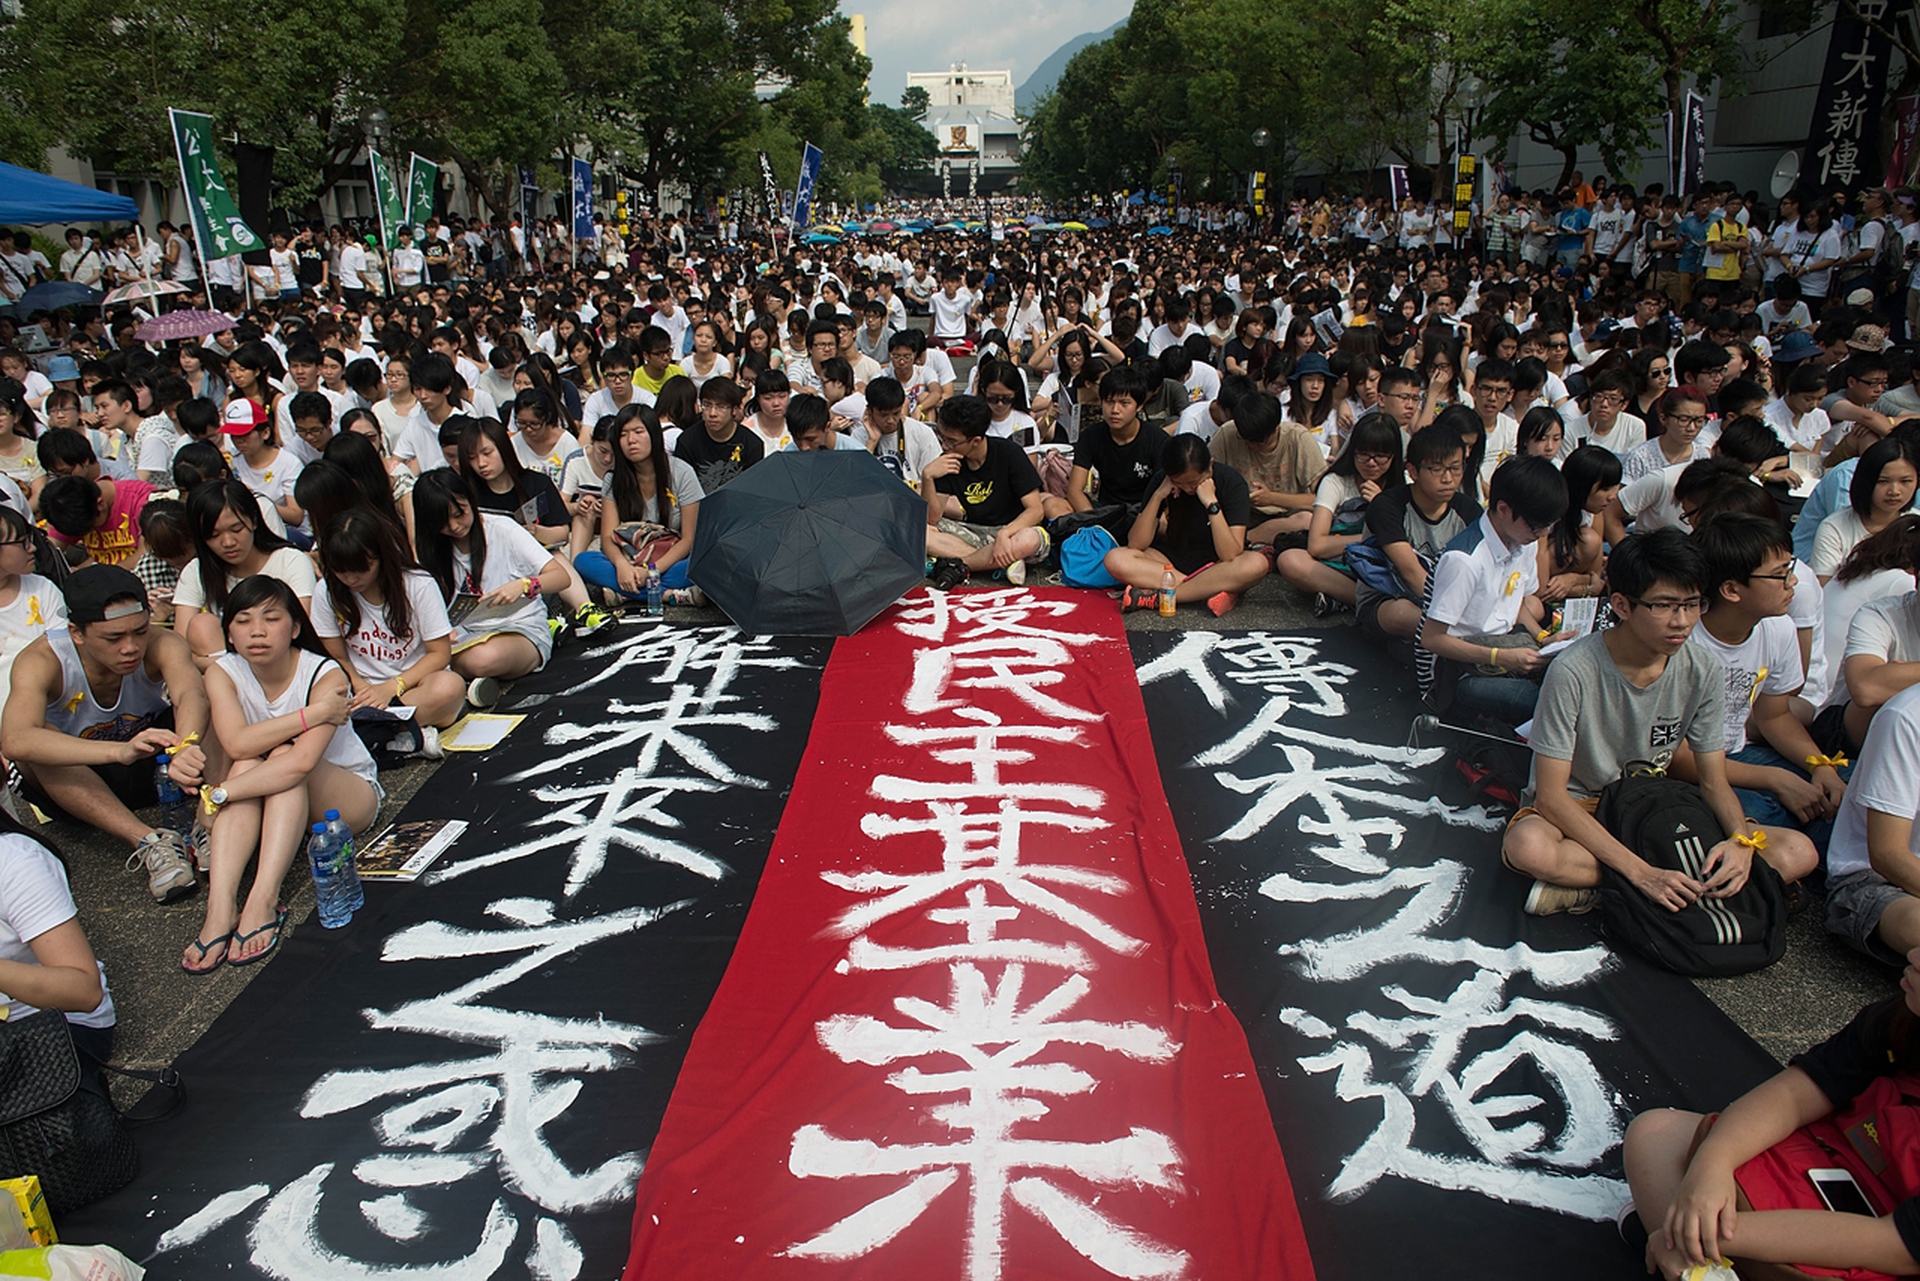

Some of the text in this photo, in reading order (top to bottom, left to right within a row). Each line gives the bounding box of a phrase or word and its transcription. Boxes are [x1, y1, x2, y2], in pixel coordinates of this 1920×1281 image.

[184, 127, 225, 191] 公大
[414, 170, 432, 210] 公大
[156, 624, 823, 1281] 解未來之惑
[774, 586, 1194, 1281] 授民主基業
